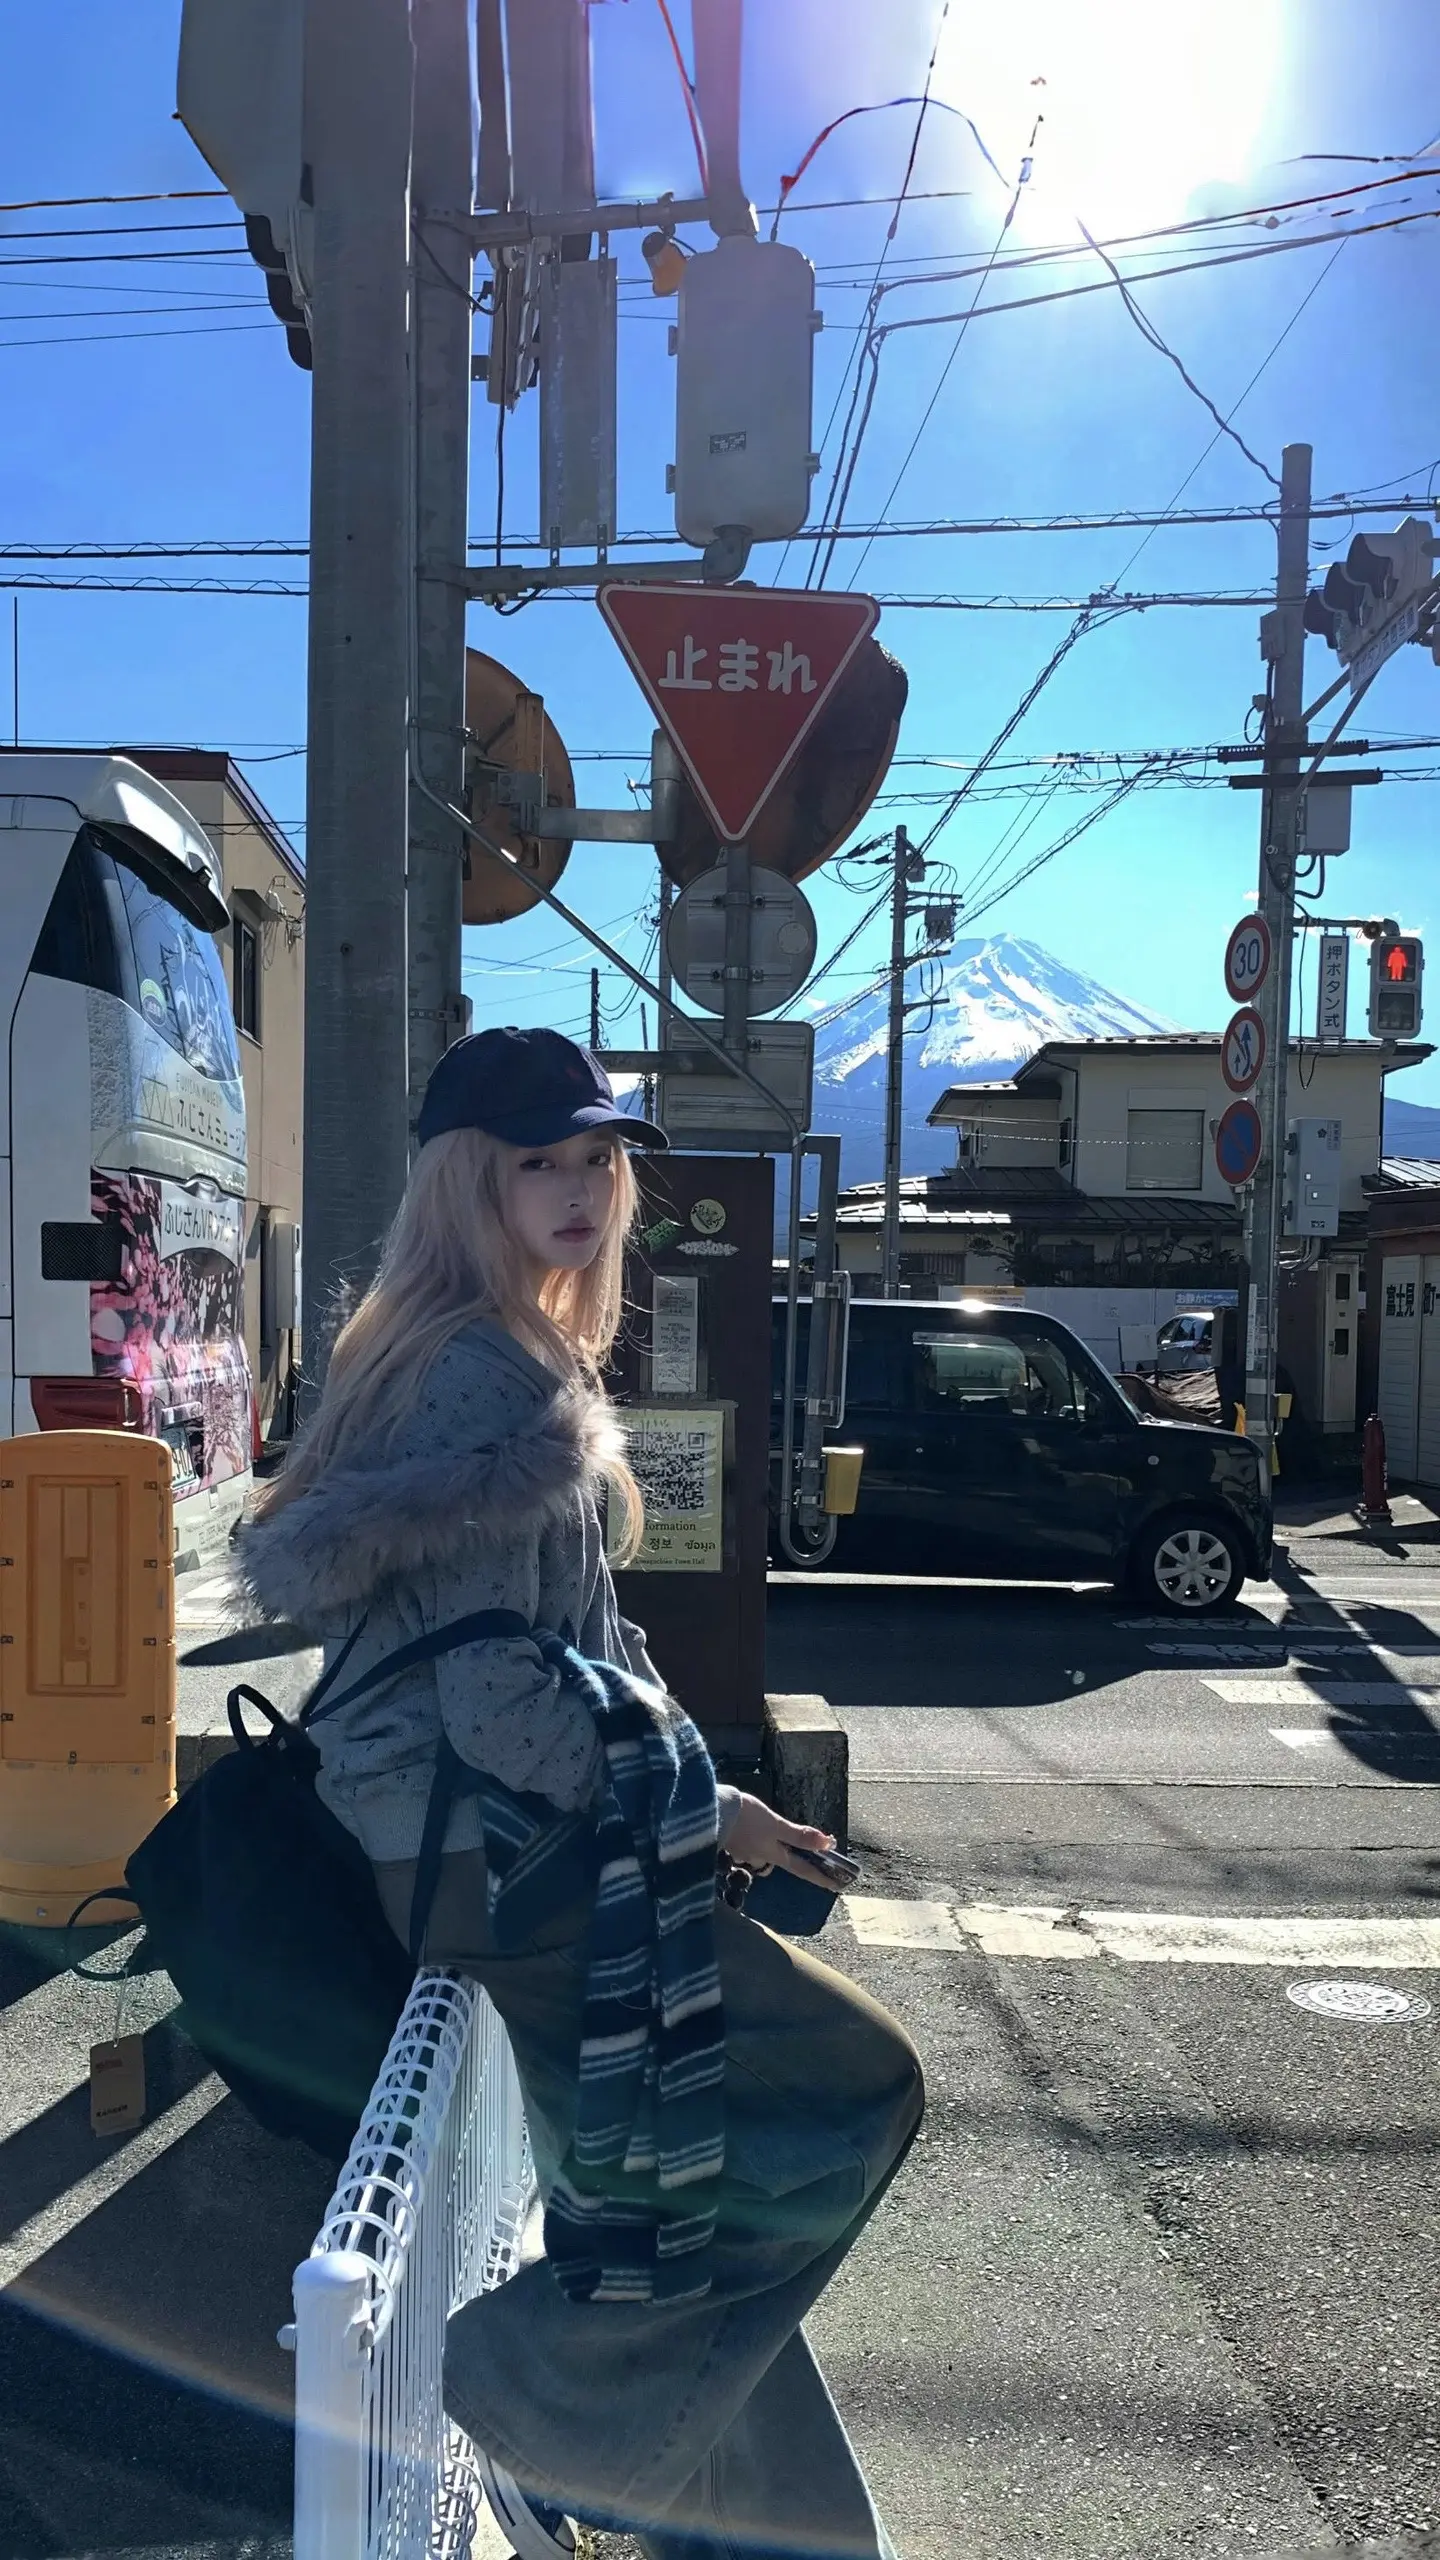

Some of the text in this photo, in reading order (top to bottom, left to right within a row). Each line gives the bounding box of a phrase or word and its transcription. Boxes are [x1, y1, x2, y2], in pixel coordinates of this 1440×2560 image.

[658, 635, 818, 695] 止まれ
[1234, 938, 1261, 979] 30
[1324, 945, 1343, 1028] 押ボタン式
[649, 1538, 673, 1550] 정보
[684, 1539, 716, 1553] ข้อมูล
